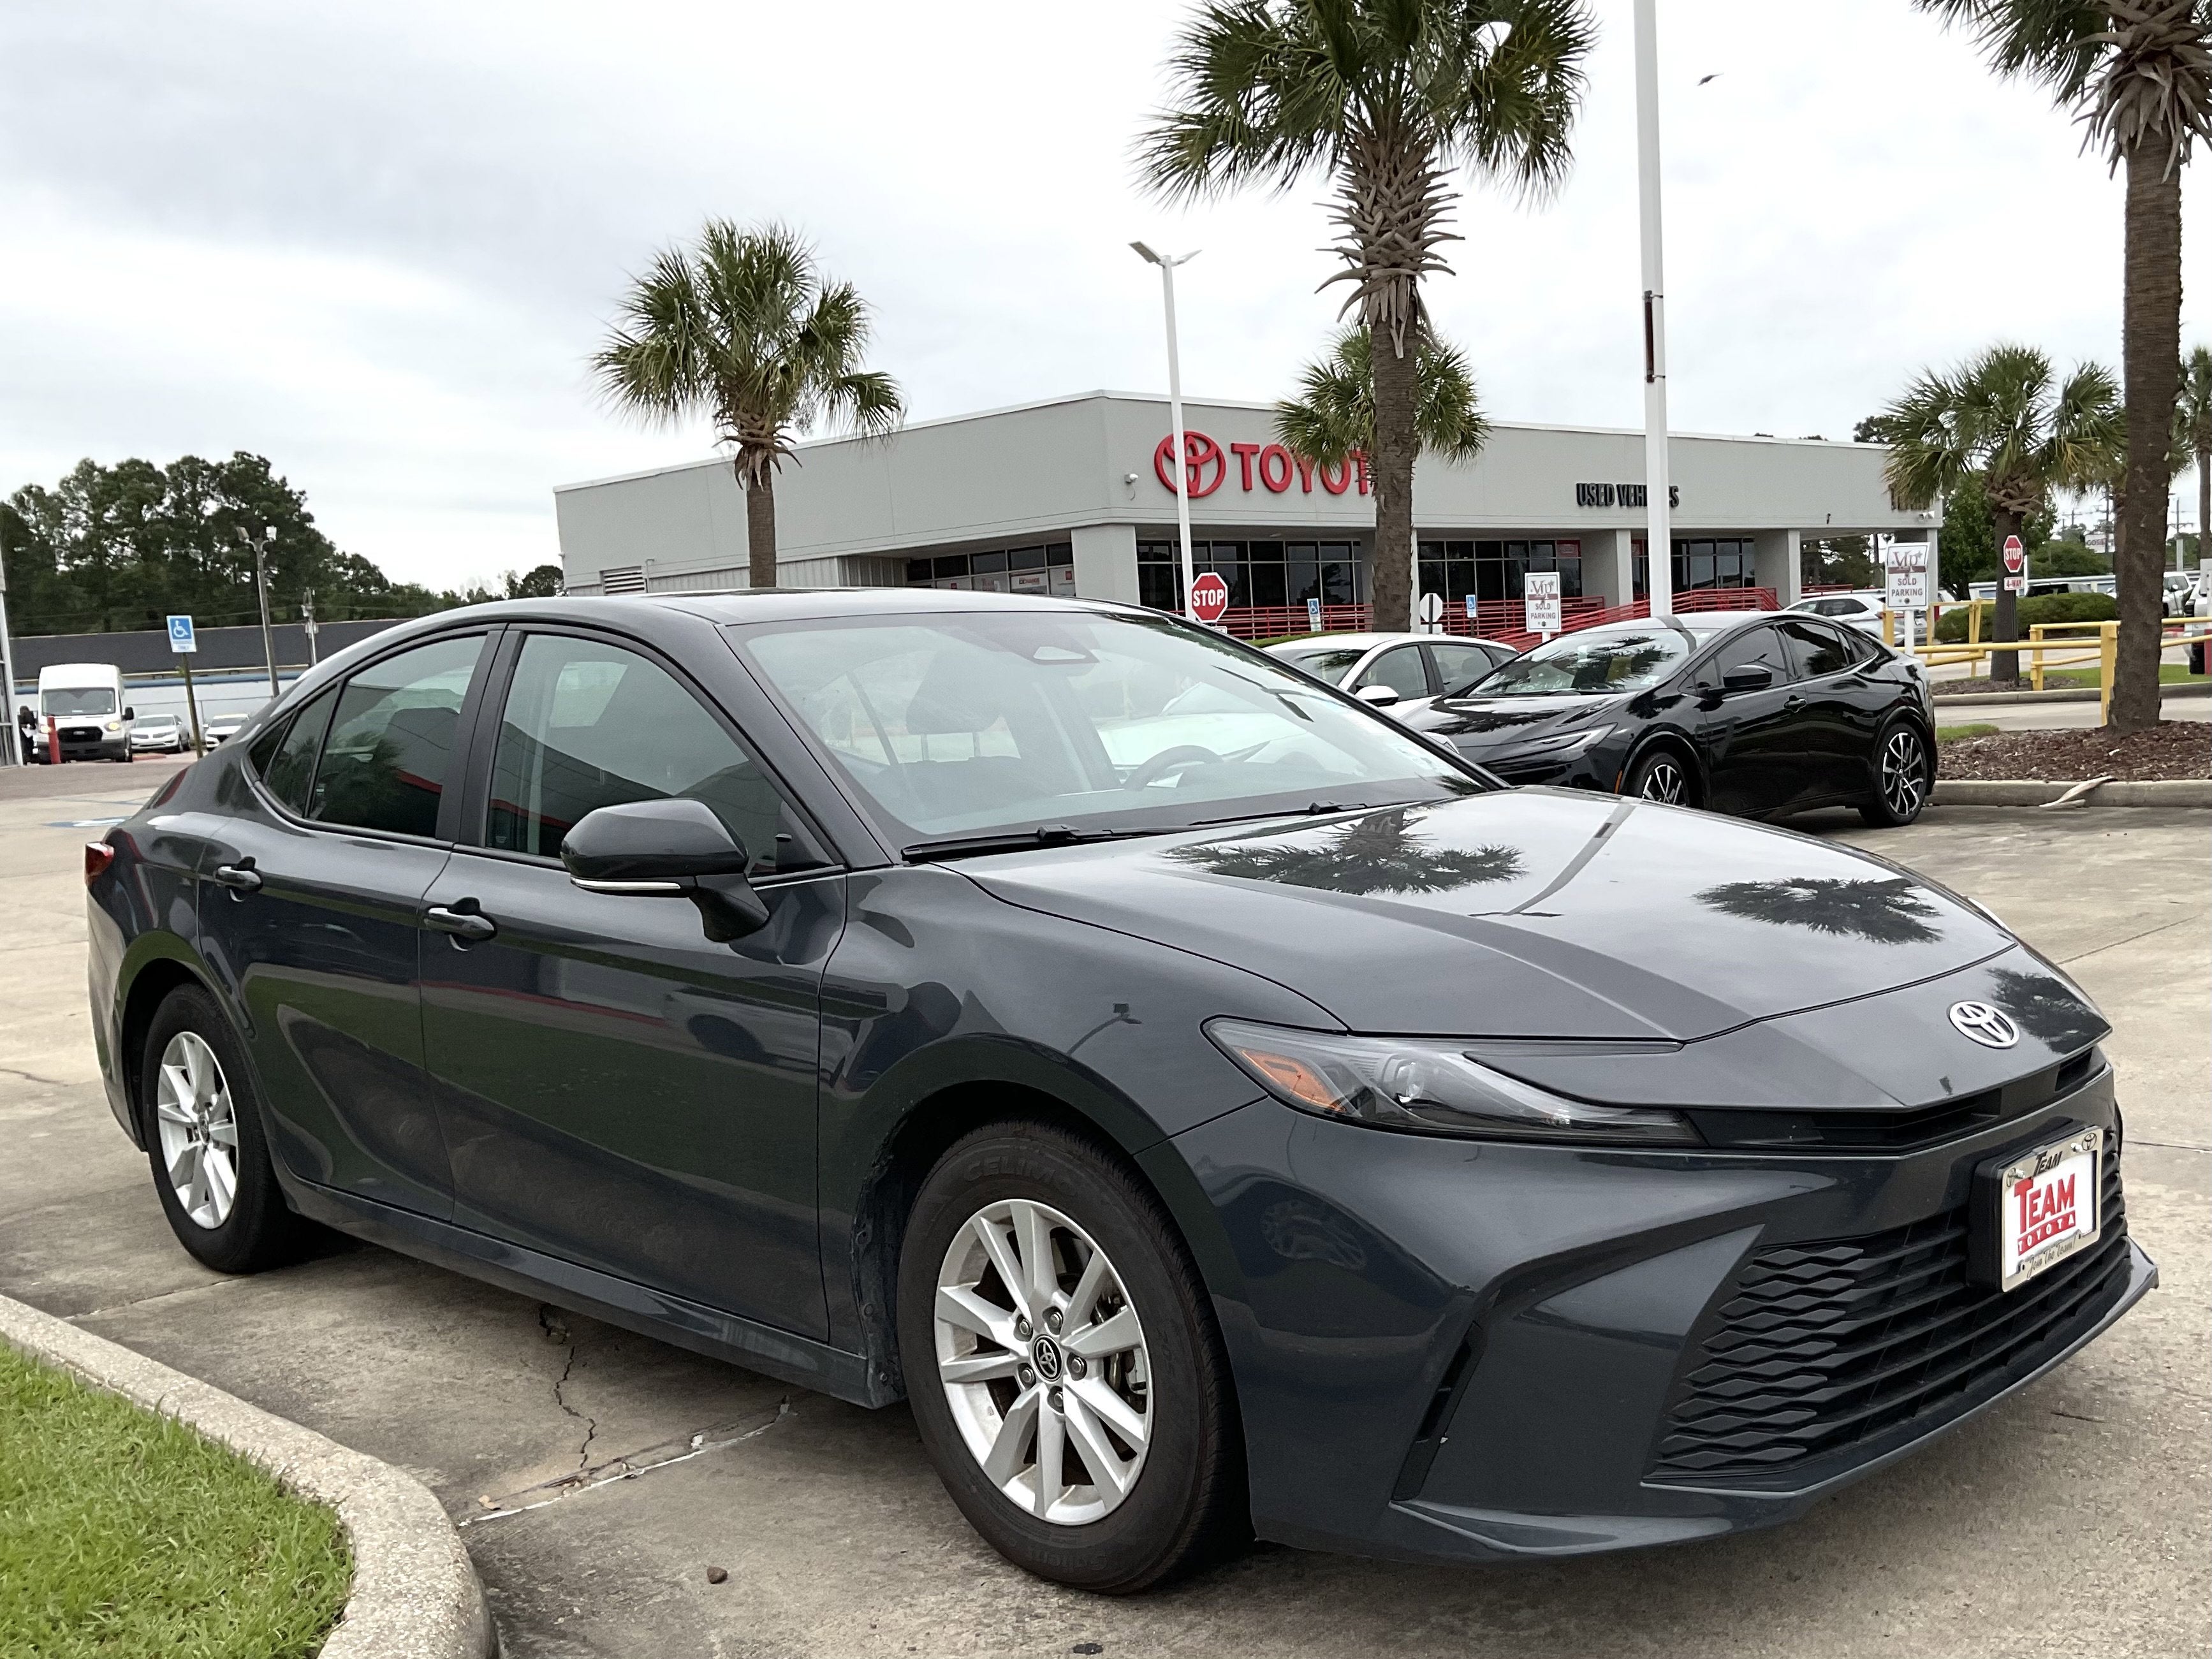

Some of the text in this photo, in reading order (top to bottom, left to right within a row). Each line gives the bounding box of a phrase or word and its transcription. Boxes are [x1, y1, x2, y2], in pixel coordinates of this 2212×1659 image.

[1231, 442, 1371, 495] TOYOT
[1576, 483, 1680, 508] USED VEHS
[2005, 548, 2021, 560] STOP
[1891, 588, 1923, 597] PARKING
[2006, 579, 2022, 588] 4-WAY
[1193, 588, 1224, 606] STOP
[2033, 1150, 2063, 1176] TEAM
[2014, 1173, 2076, 1234] TEAM
[2018, 1213, 2075, 1253] TOYOTA
